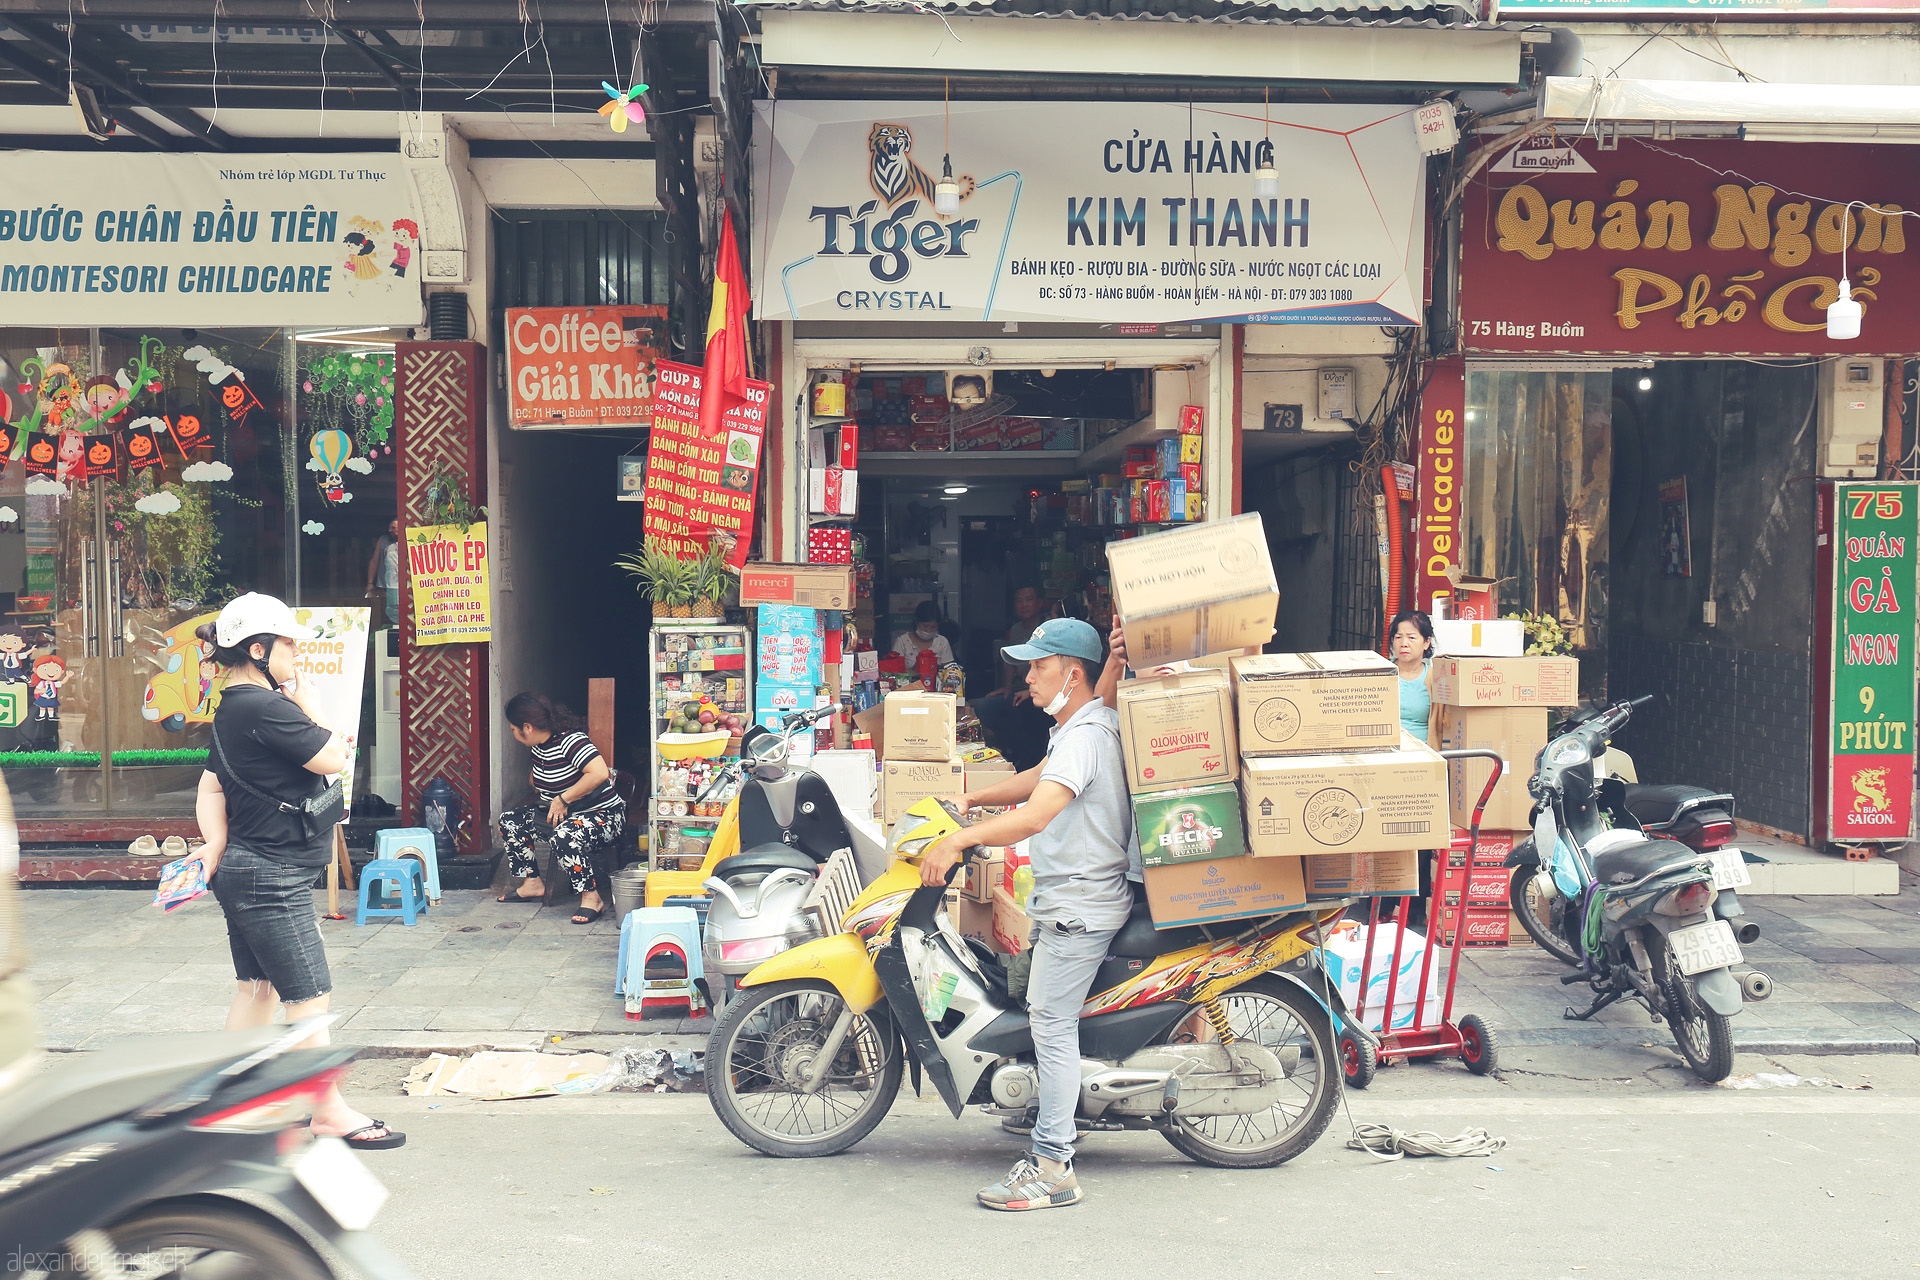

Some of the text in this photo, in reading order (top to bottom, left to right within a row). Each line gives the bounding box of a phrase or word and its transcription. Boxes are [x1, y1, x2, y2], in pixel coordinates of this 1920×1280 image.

[1419, 106, 1441, 121] P035
[1423, 120, 1445, 134] 542H
[1103, 128, 1275, 174] CỬA HÀNG
[219, 168, 386, 183] Nhóm trẻ lớp MGDL Tư Thục
[0, 199, 338, 243] BƯỚC CHÂN ĐẦU TIÊN
[1066, 196, 1310, 248] KIM THANH
[1495, 179, 1906, 268] Quán Ngon
[808, 199, 980, 283] Tiger
[1, 264, 332, 293] MONTESORI CHILDCARE
[1011, 258, 1381, 280] BÁNH KẸO RƯỢU BIA ĐƯỜNG SỮA NƯỚC NGỌT CÁC LOẠI
[836, 290, 952, 310] CRYSTAL
[1039, 284, 1353, 302] ĐC: SỐ 73 HÀNG BUỒM HOÀN KIẾM HÀ NỘI ĐT: 079 303 1080
[1611, 267, 1765, 331] Phố
[513, 313, 622, 355] Coffee
[1471, 319, 1585, 339] 75 Hàng Buồm
[517, 361, 581, 401] Giải
[660, 369, 690, 387] GIÚP
[658, 388, 681, 404] MÓN
[746, 387, 766, 407] HỢ
[515, 407, 531, 418] ĐC:
[533, 407, 542, 418] 71
[545, 406, 567, 420] Hàng
[569, 405, 593, 418] Buồm
[600, 407, 615, 417] ĐT:
[616, 406, 631, 417] 039
[633, 406, 643, 417] 22
[666, 404, 677, 415] 71
[743, 406, 762, 423] NỘI
[1273, 409, 1295, 428] 73
[653, 415, 700, 441] BÁNH ĐẬU
[726, 420, 738, 429] 039
[737, 422, 749, 432] 229
[652, 434, 720, 464] BÁNH CỐM XÀO
[650, 454, 720, 485] BÁNH CỐM TƯƠI
[647, 474, 752, 513] BÁNH KHẢO BÁNH CHẢ
[1426, 408, 1455, 577] Delicacies
[646, 493, 741, 530] SẤU TƯƠI SẤU NGÂM
[1847, 490, 1903, 520] 75
[653, 516, 690, 537] MAI SẤU
[410, 533, 486, 576] NƯỚC ÉP
[1846, 531, 1905, 562] QUÁN
[749, 577, 788, 587] merci
[1849, 566, 1901, 613] GÀ
[432, 588, 470, 600] CHANH LEO
[424, 601, 481, 614] CAM CHANH LEO
[298, 640, 345, 655] come
[1848, 633, 1900, 666] NGON
[296, 656, 343, 675] chool
[1474, 675, 1502, 683] HENRY
[1476, 687, 1502, 701] Wafers
[1858, 685, 1875, 714] 9
[1839, 712, 1907, 750] PHÚT
[1847, 813, 1894, 825] SAIGON
[1863, 806, 1878, 814] BIA
[1158, 825, 1224, 847] BECK'S
[1175, 847, 1210, 856] QUALITY
[1469, 881, 1508, 895] Coca-Cola
[1468, 921, 1507, 935] Coca-Cola
[1681, 943, 1738, 973] 770.39
